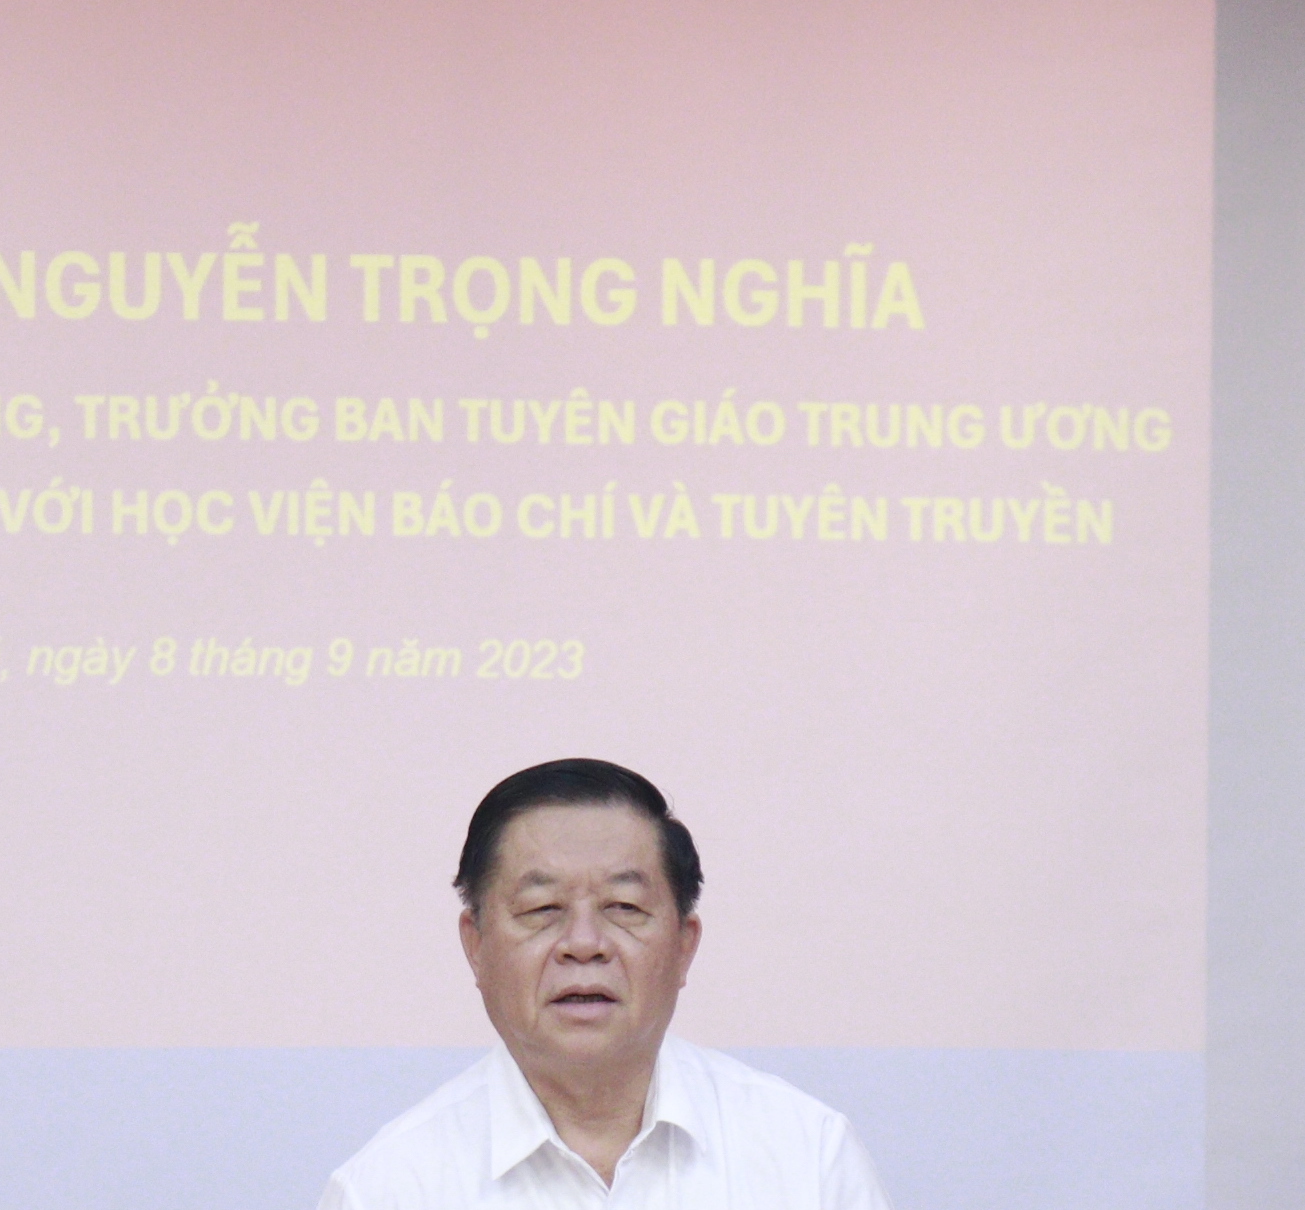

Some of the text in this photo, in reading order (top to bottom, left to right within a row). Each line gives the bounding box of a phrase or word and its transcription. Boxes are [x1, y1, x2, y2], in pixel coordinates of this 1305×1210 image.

[349, 253, 639, 340] TRỌNG
[661, 242, 926, 331] NGHĨA
[76, 379, 320, 441] TRƯỞNG
[335, 396, 444, 442] BAN
[459, 386, 637, 445] TUYÊN
[649, 387, 787, 446] GIÁO
[798, 400, 987, 450] TRUNG
[1001, 402, 1173, 452] ƯƠNG
[112, 490, 234, 544] HỌC
[249, 478, 376, 546] VIỆN
[392, 481, 503, 538] BÁO
[517, 481, 616, 538] CHÍ
[628, 481, 701, 539] VÀ
[712, 482, 889, 541] TUYÊN
[902, 481, 1114, 544] TRUYỀN
[25, 639, 135, 684] ngày
[149, 636, 176, 676] 8
[187, 637, 313, 685] tháng
[328, 638, 354, 677] 9
[365, 639, 462, 678] năm
[476, 638, 586, 679] 2023
